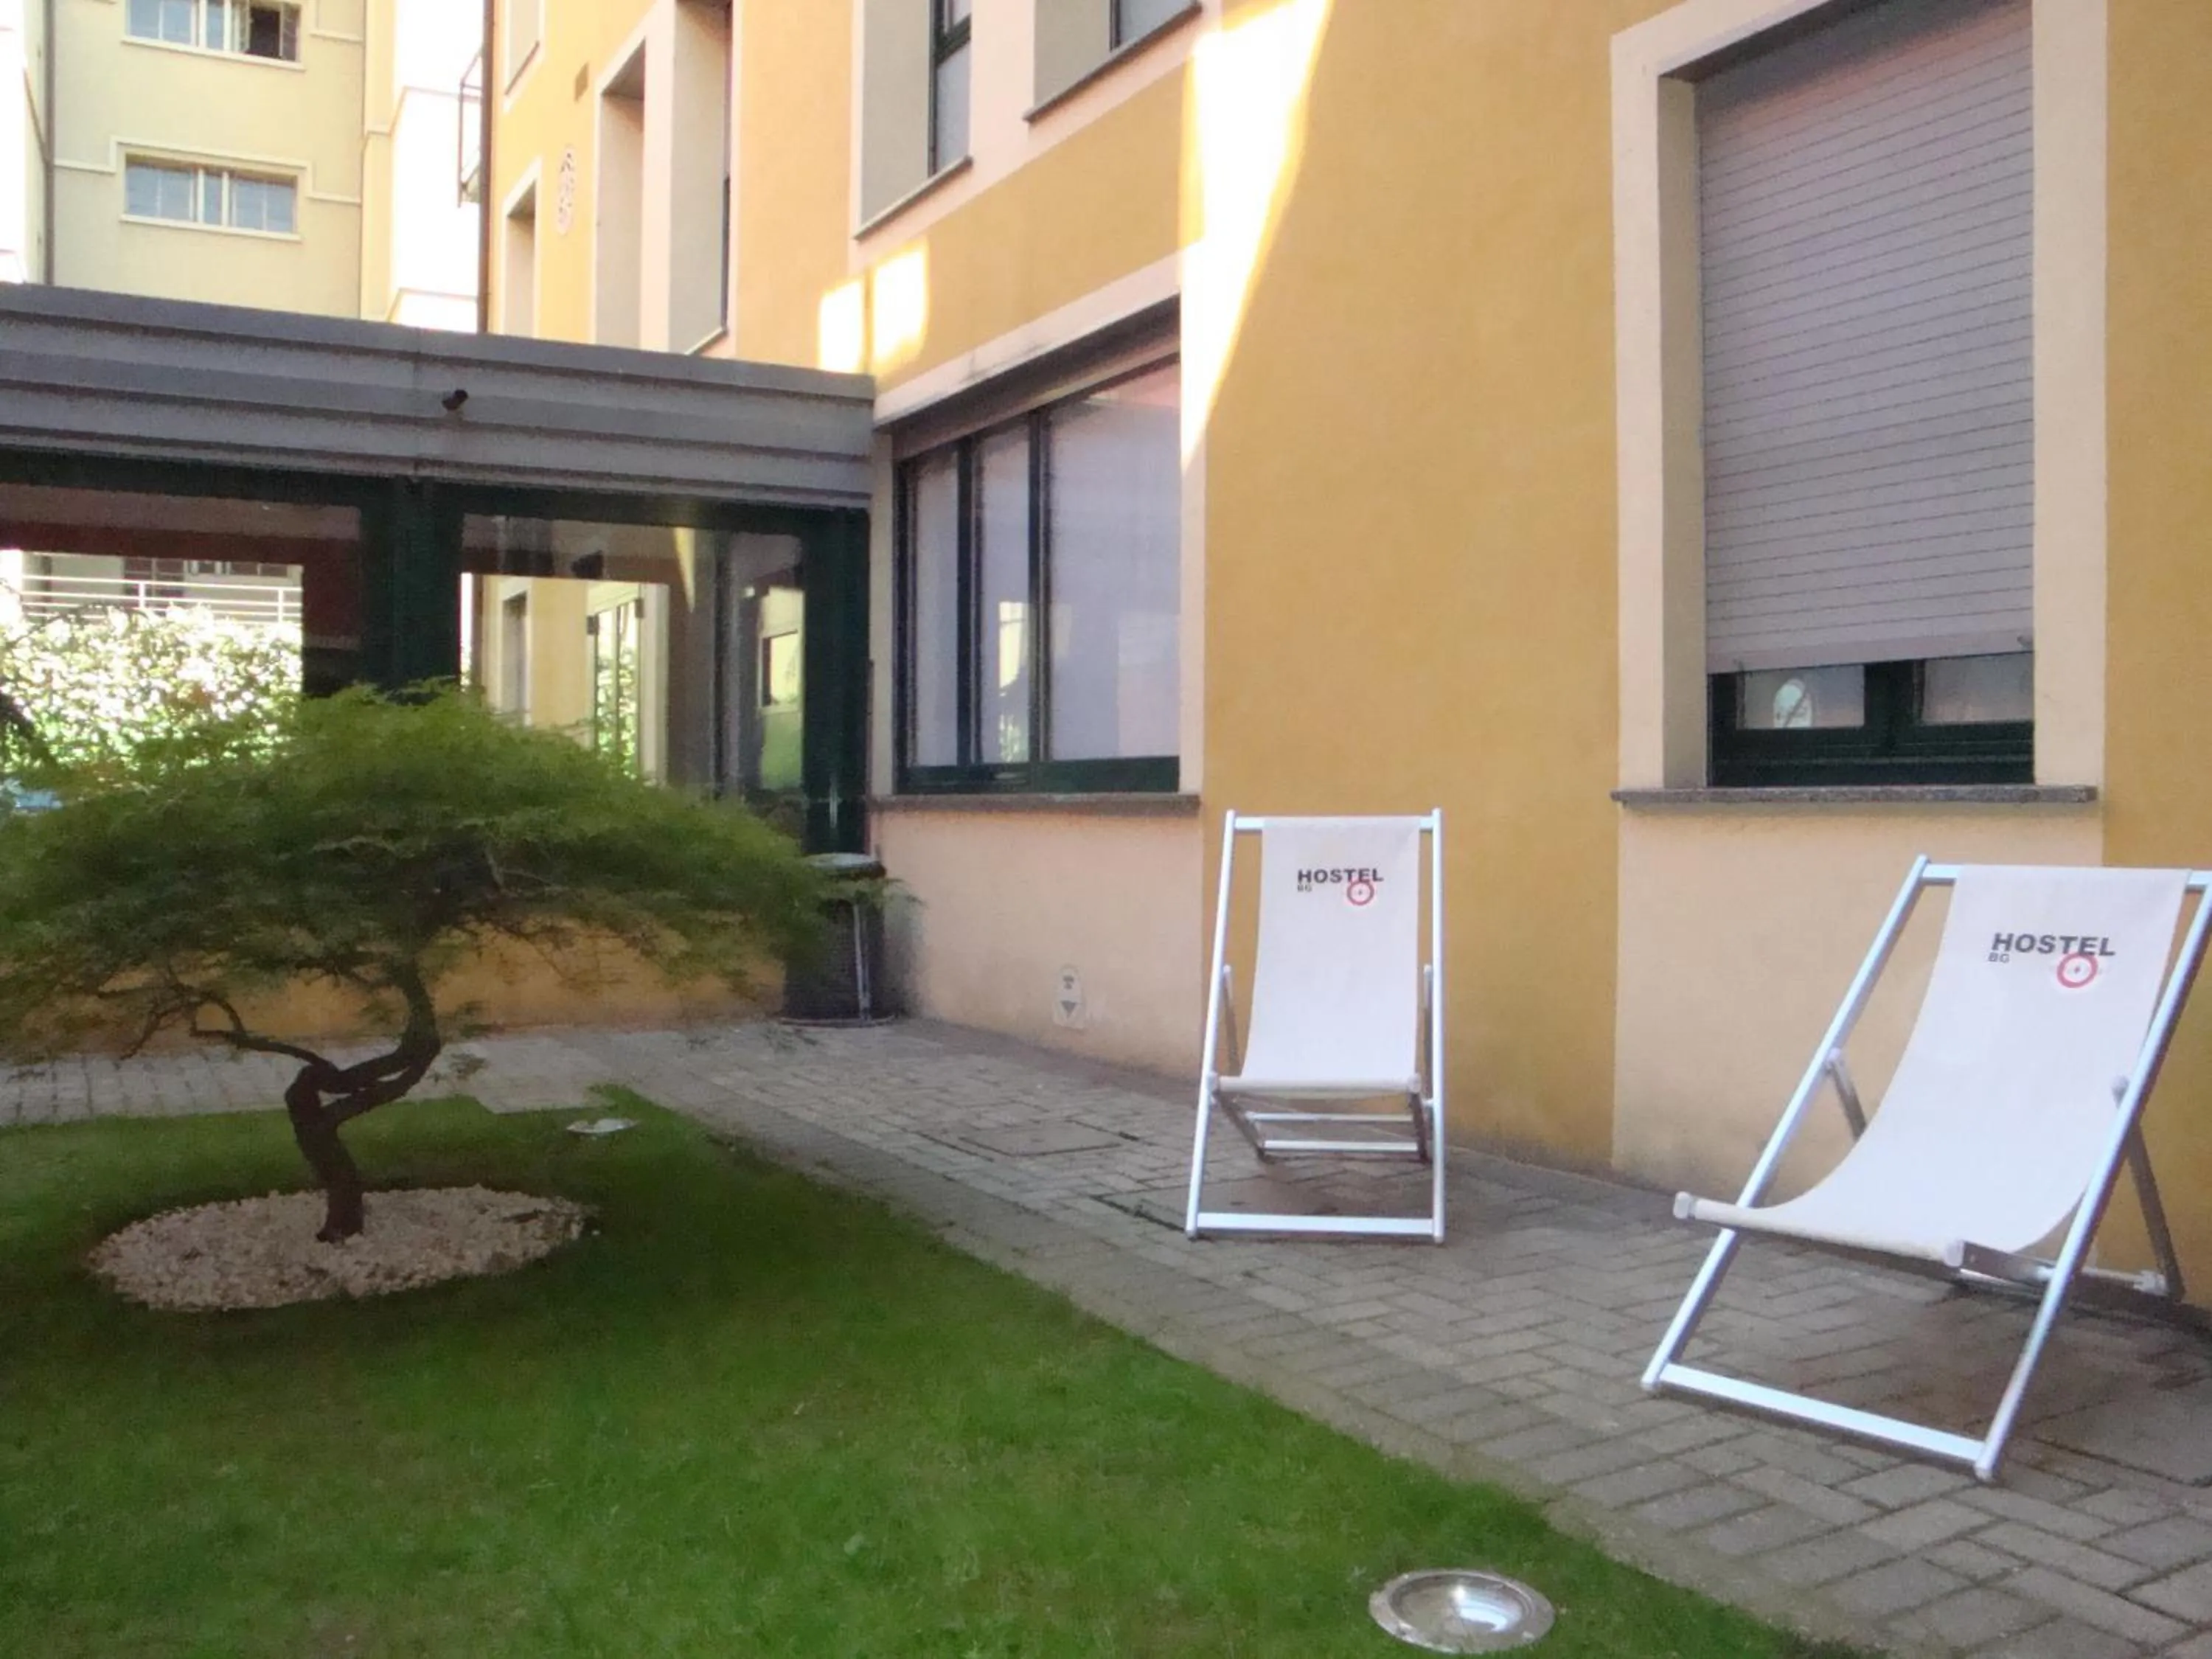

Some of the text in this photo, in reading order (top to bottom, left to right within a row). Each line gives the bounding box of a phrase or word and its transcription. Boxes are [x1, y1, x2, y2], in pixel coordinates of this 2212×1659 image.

[1298, 869, 1384, 883] HOSTEL
[1992, 933, 2115, 956] HOSTEL
[1988, 952, 2010, 963] BG
